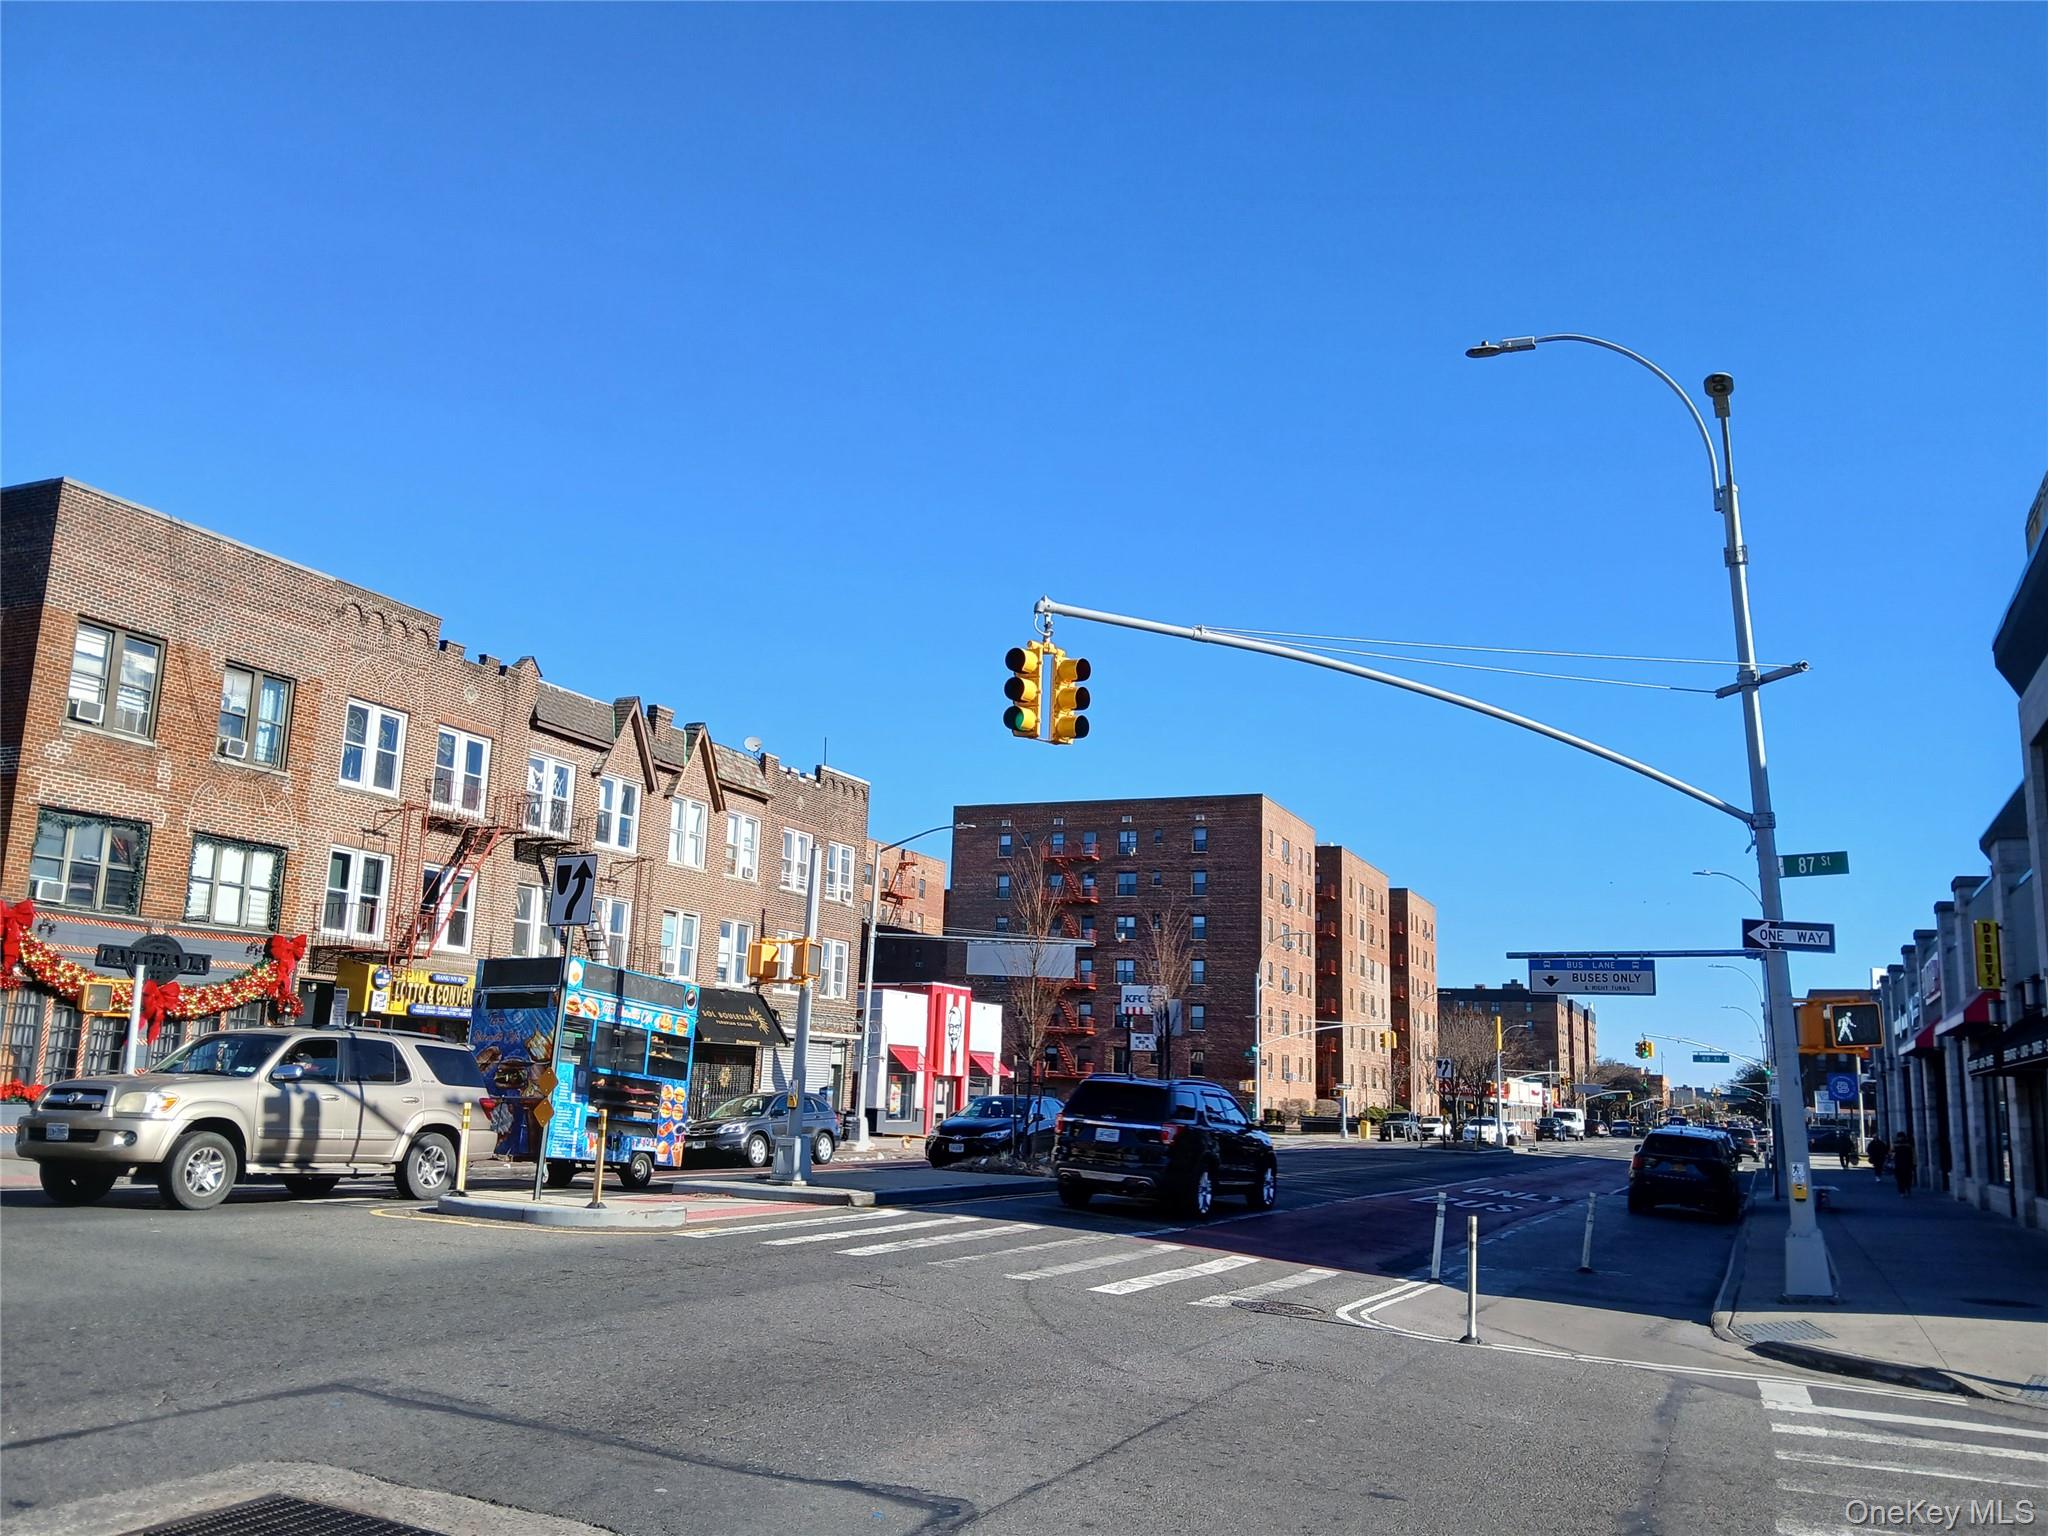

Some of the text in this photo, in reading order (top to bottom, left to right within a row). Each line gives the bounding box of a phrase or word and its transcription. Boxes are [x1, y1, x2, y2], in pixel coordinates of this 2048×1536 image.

[1798, 855, 1832, 874] 87 St
[1760, 929, 1825, 944] ONE WAY
[1566, 961, 1616, 970] BUS LANE
[1572, 972, 1641, 983] BUSES ONLY
[395, 981, 427, 1003] LOTTO
[1124, 994, 1145, 1003] KFC
[1461, 1187, 1563, 1203] ONLY
[1408, 1195, 1525, 1213] BUS
